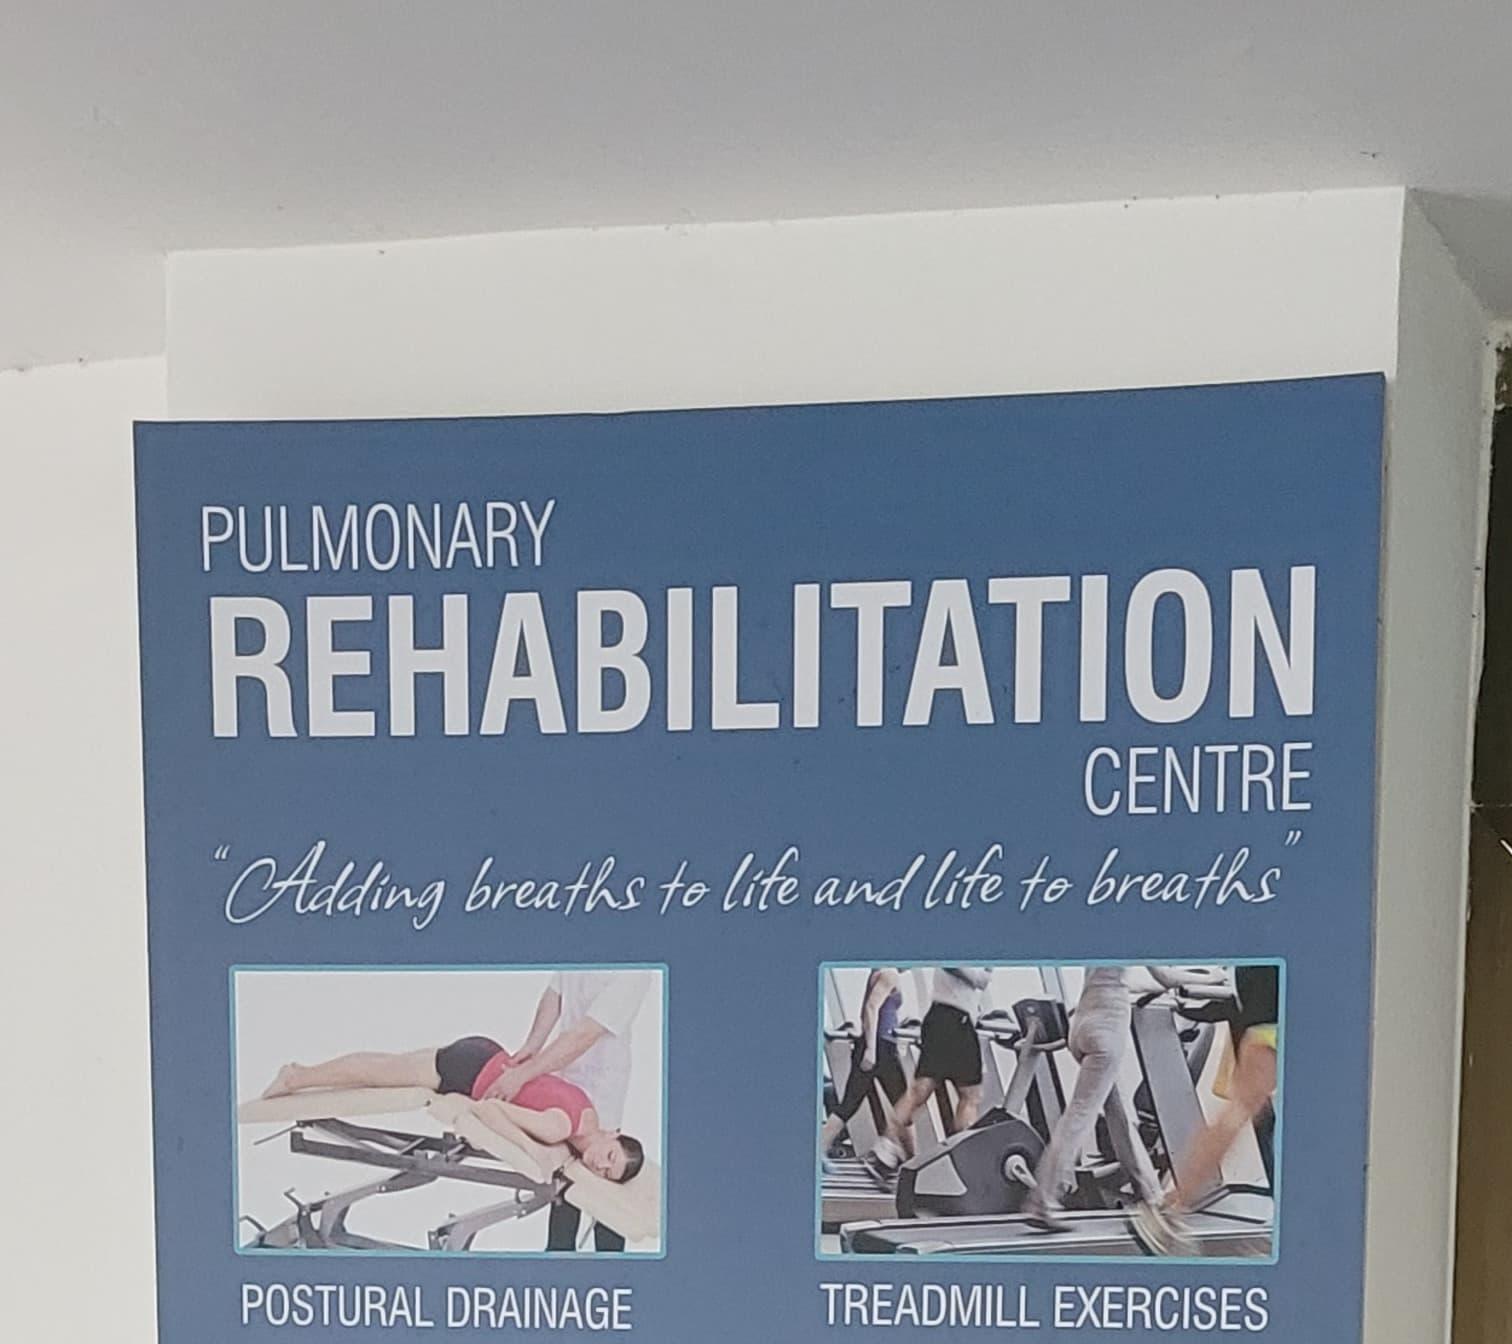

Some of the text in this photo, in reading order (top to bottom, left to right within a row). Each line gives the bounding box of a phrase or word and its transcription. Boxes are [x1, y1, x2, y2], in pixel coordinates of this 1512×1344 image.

[201, 499, 555, 571] PULMONARY
[209, 565, 1317, 737] REHABILITATION
[1082, 742, 1313, 815] CENTRE
[465, 857, 646, 915] breaths
[660, 861, 710, 915] to
[723, 846, 799, 911] life
[813, 854, 925, 910] and
[923, 844, 1004, 910] life
[1020, 855, 1073, 911] to
[241, 1283, 633, 1330] POSTURAL DRAINAGE
[820, 1283, 1268, 1332] TREADMILL EXERCISES
